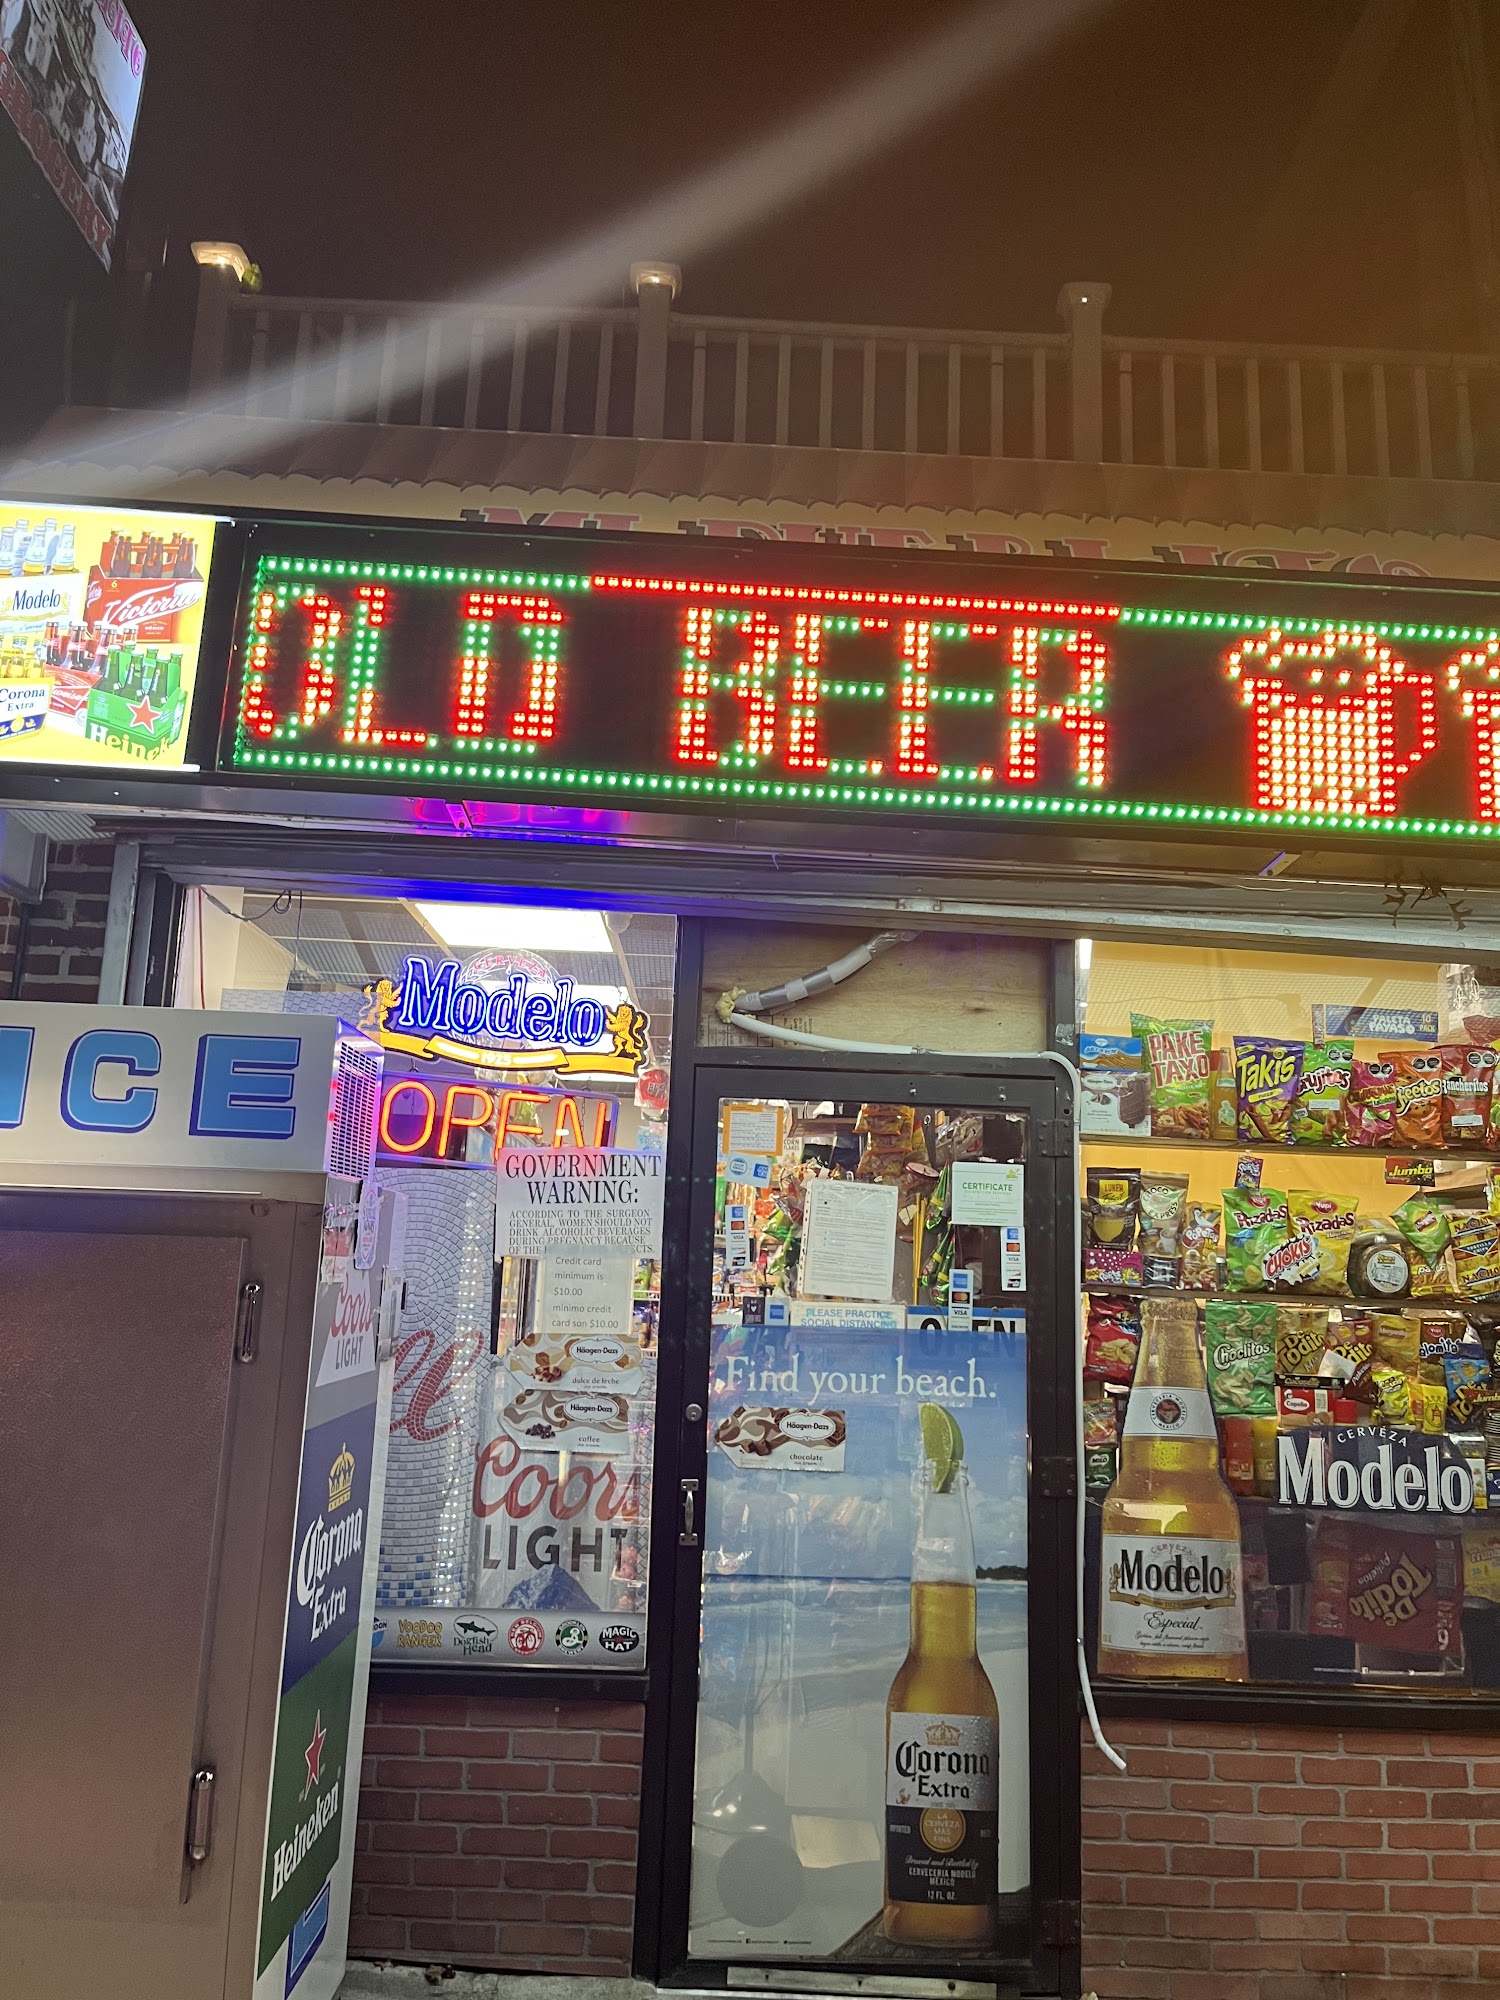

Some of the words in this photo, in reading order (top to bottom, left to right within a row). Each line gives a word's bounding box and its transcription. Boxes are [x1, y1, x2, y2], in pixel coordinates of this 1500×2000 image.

[12, 588, 61, 611] Modelo
[103, 582, 202, 627] Victoria
[674, 604, 1110, 789] BEER
[7, 701, 34, 711] Extra
[473, 955, 548, 978] CERVEZA
[398, 955, 605, 1047] Modelo
[1372, 1014, 1411, 1024] PALETA
[1421, 1013, 1432, 1023] 10
[1368, 1022, 1416, 1034] PAYASO
[1419, 1024, 1436, 1033] PACK
[1148, 1031, 1206, 1064] PAKE
[1151, 1055, 1210, 1088] TAXO
[1237, 1048, 1296, 1099] Takis
[0, 1026, 302, 1140] ICE
[506, 1154, 662, 1179] GOVERNMENT
[1389, 1164, 1433, 1177] Jumbo
[526, 1179, 639, 1205] WARNING:
[962, 1182, 1013, 1192] CERTIFICATE
[1143, 1186, 1169, 1202] CHOCO
[1148, 1201, 1178, 1219] EXPRESS
[1315, 1201, 1332, 1210] Yupi
[509, 1210, 564, 1219] ACCORDING
[567, 1210, 580, 1218] TO
[584, 1209, 602, 1218] THE
[606, 1209, 651, 1218] SURGEON
[1233, 1205, 1288, 1229] Rizadas
[509, 1219, 555, 1228] GENERAL,
[559, 1219, 593, 1227] WOMEN
[595, 1218, 632, 1227] SHOULD
[634, 1218, 653, 1227] NOT
[1298, 1212, 1355, 1235] Rizadas
[509, 1228, 538, 1237] DRINK
[544, 1228, 596, 1237] ALCOHOLIC
[598, 1227, 651, 1236] BEVERAGES
[509, 1237, 545, 1246] DURING
[549, 1236, 602, 1245] PREGNANCY
[604, 1236, 646, 1245] BECAUSE
[508, 1246, 521, 1254] OF
[524, 1246, 542, 1254] THE
[1266, 1236, 1312, 1279] CHOKIS
[555, 1257, 581, 1265] Credit
[583, 1258, 602, 1266] card
[555, 1272, 595, 1280] minimum
[597, 1272, 604, 1280] is
[554, 1287, 583, 1296] $10.00
[587, 1305, 611, 1313] credit
[805, 1308, 842, 1318] PLEASE
[845, 1309, 893, 1319] PRACTICE
[552, 1319, 570, 1327] card
[589, 1319, 619, 1328] $10.00
[800, 1318, 835, 1327] SOCIAL
[839, 1319, 897, 1329] DISTANCING
[335, 1336, 364, 1370] LIGHT
[576, 1346, 618, 1356] Häagen-Dazs
[1213, 1342, 1271, 1370] Choclitos
[572, 1377, 590, 1385] dulce
[725, 1353, 799, 1395] Find
[808, 1371, 886, 1406] your
[896, 1355, 997, 1398] beach.
[570, 1403, 613, 1413] Häagen-Dazs
[786, 1421, 829, 1431] Häagen-Dazs
[1337, 1426, 1408, 1447] CERVEZA
[789, 1453, 823, 1461] chocolate
[472, 1435, 640, 1521] Coors
[1277, 1435, 1474, 1514] Modelo
[482, 1524, 629, 1573] LIGHT
[1150, 1543, 1193, 1557] CERVEZA
[296, 1507, 363, 1608] Corona
[1120, 1549, 1225, 1594] Modelo
[1348, 1551, 1432, 1622] Todito
[311, 1582, 348, 1642] Extra
[1382, 1597, 1418, 1627] De
[398, 1619, 443, 1634] VOODOO
[1143, 1611, 1203, 1633] Especial
[602, 1626, 637, 1639] MAGIC
[1437, 1628, 1450, 1651] 6
[397, 1634, 442, 1648] RANGER
[453, 1637, 490, 1646] Dogfish
[463, 1643, 492, 1655] Head
[605, 1641, 633, 1651] HAT
[895, 1741, 991, 1783] Corona
[917, 1774, 970, 1800] Extra
[270, 1782, 340, 1902] Heineken
[908, 1867, 949, 1877] CERVECERIA
[927, 1890, 935, 1899] 12
